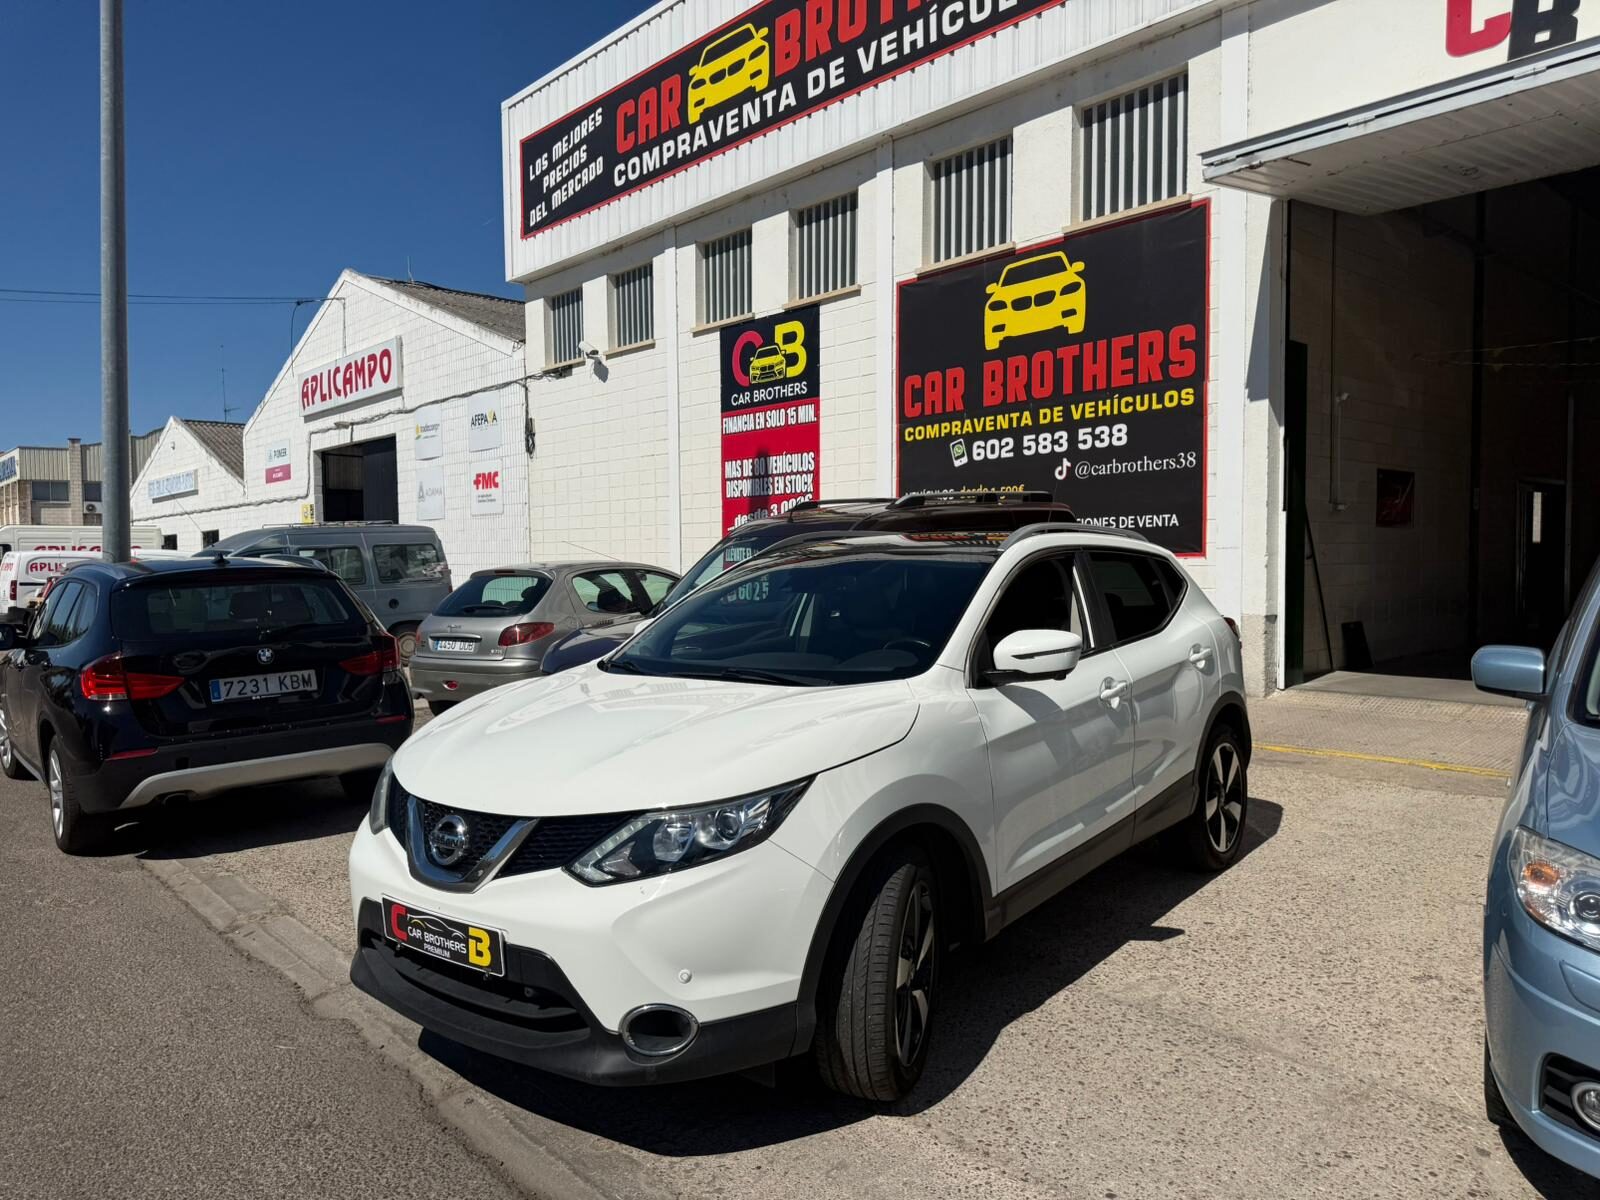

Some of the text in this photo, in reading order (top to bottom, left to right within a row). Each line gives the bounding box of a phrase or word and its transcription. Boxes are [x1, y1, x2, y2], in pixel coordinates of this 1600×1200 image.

[616, 0, 930, 154] CAR BRO
[613, 82, 797, 187] COMPRAVENTA
[807, 57, 845, 99] DE
[529, 107, 603, 181] LOS MEJORES
[543, 144, 588, 194] PRECIOS
[529, 156, 604, 227] DEL MERCADO
[301, 348, 393, 411] APLICAMPO
[904, 324, 1197, 418] CAR BROTHERS
[731, 381, 808, 406] CAR BROTHERS
[723, 404, 817, 434] FINANCIA EN SOLO 15 MIN.
[904, 387, 1195, 442] COMPRAVENTA DE VEHÍCULOS
[972, 423, 1128, 462] 602 583 538
[473, 471, 499, 490] FMC
[725, 460, 742, 479] MAS
[743, 459, 753, 477] DE
[767, 451, 815, 475] VEHÍCULOS
[1074, 451, 1197, 479] @carbrothers38
[726, 473, 814, 498] DISPONIBLES EN STOCK
[1119, 516, 1135, 528] DE
[1136, 514, 1179, 528] VENTA
[223, 673, 313, 697] 7231 KBM
[391, 904, 492, 967] C CAR BROTHERS B
[423, 942, 451, 958] PREMIUM
